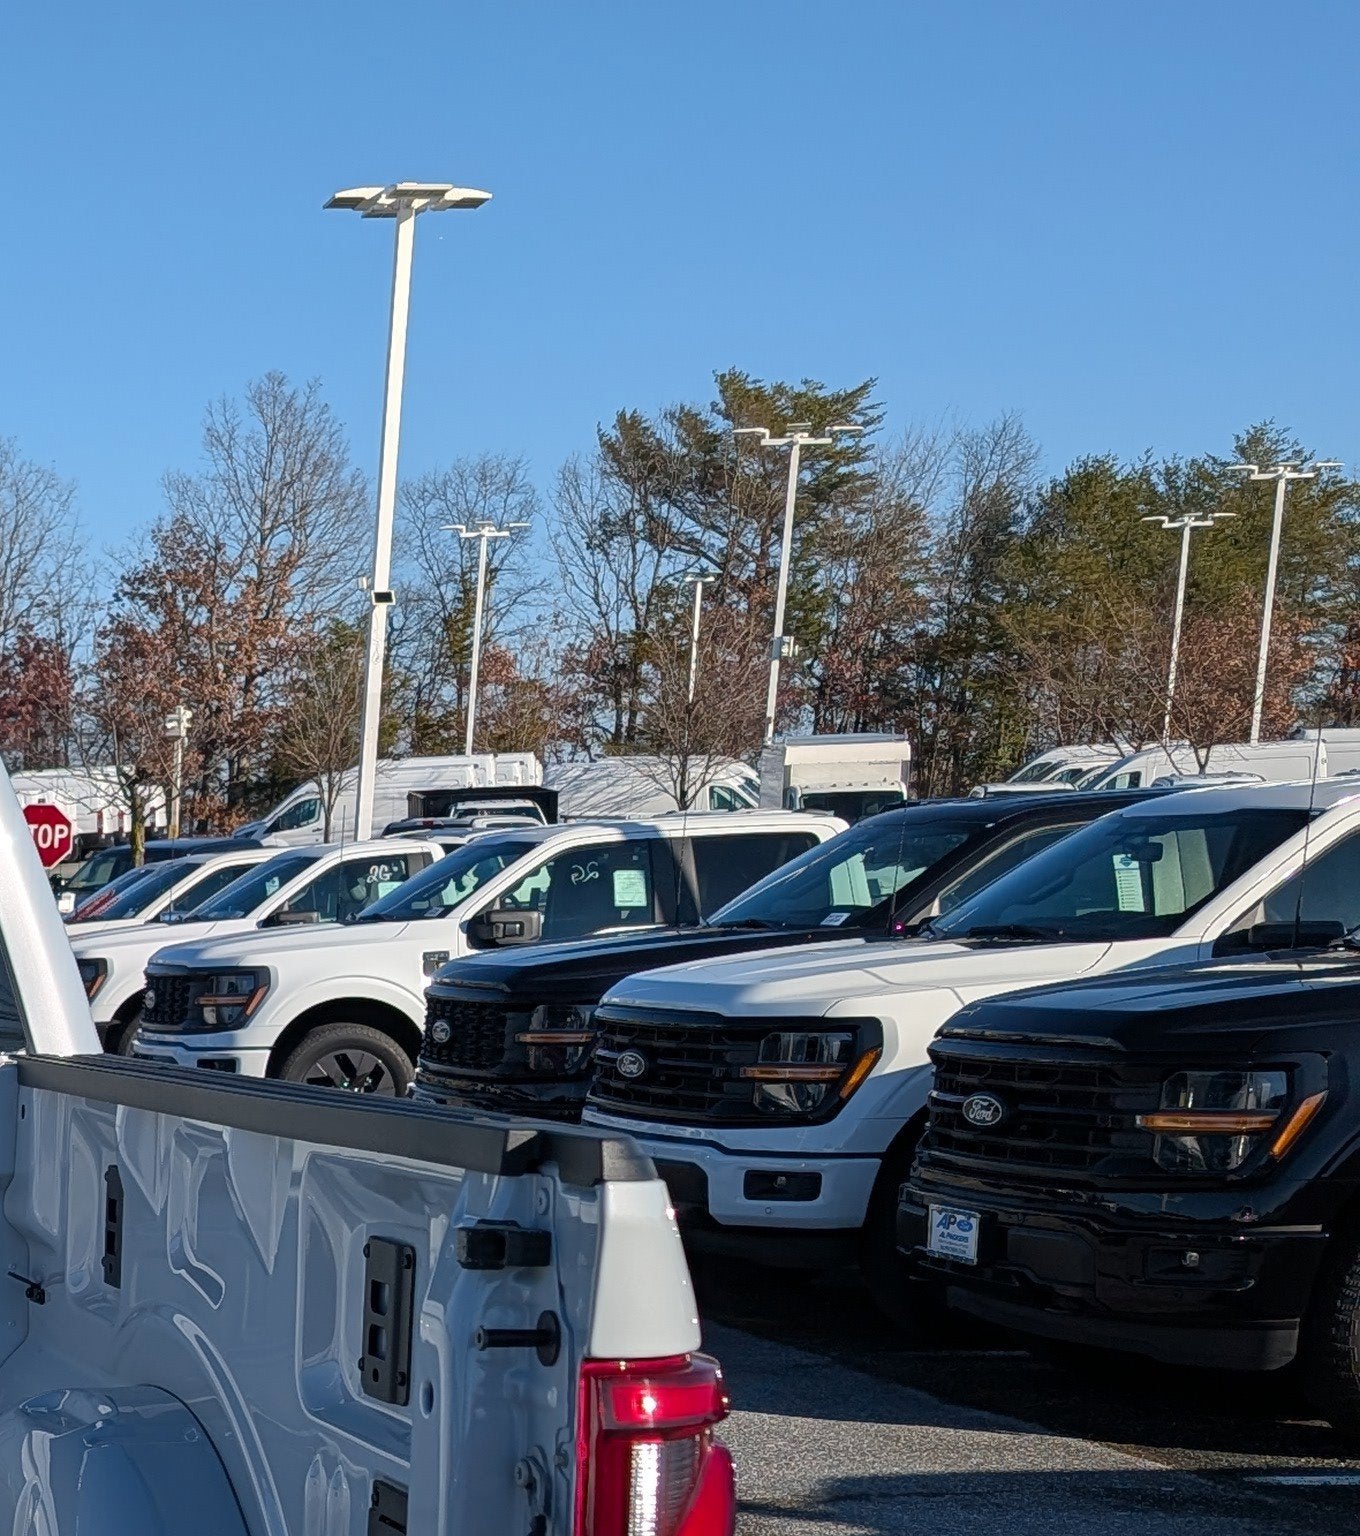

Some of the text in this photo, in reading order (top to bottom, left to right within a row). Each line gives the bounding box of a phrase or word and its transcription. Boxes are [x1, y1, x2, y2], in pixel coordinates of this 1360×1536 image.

[29, 824, 69, 850] TOP
[969, 1100, 996, 1120] Ford
[936, 1213, 957, 1230] AP
